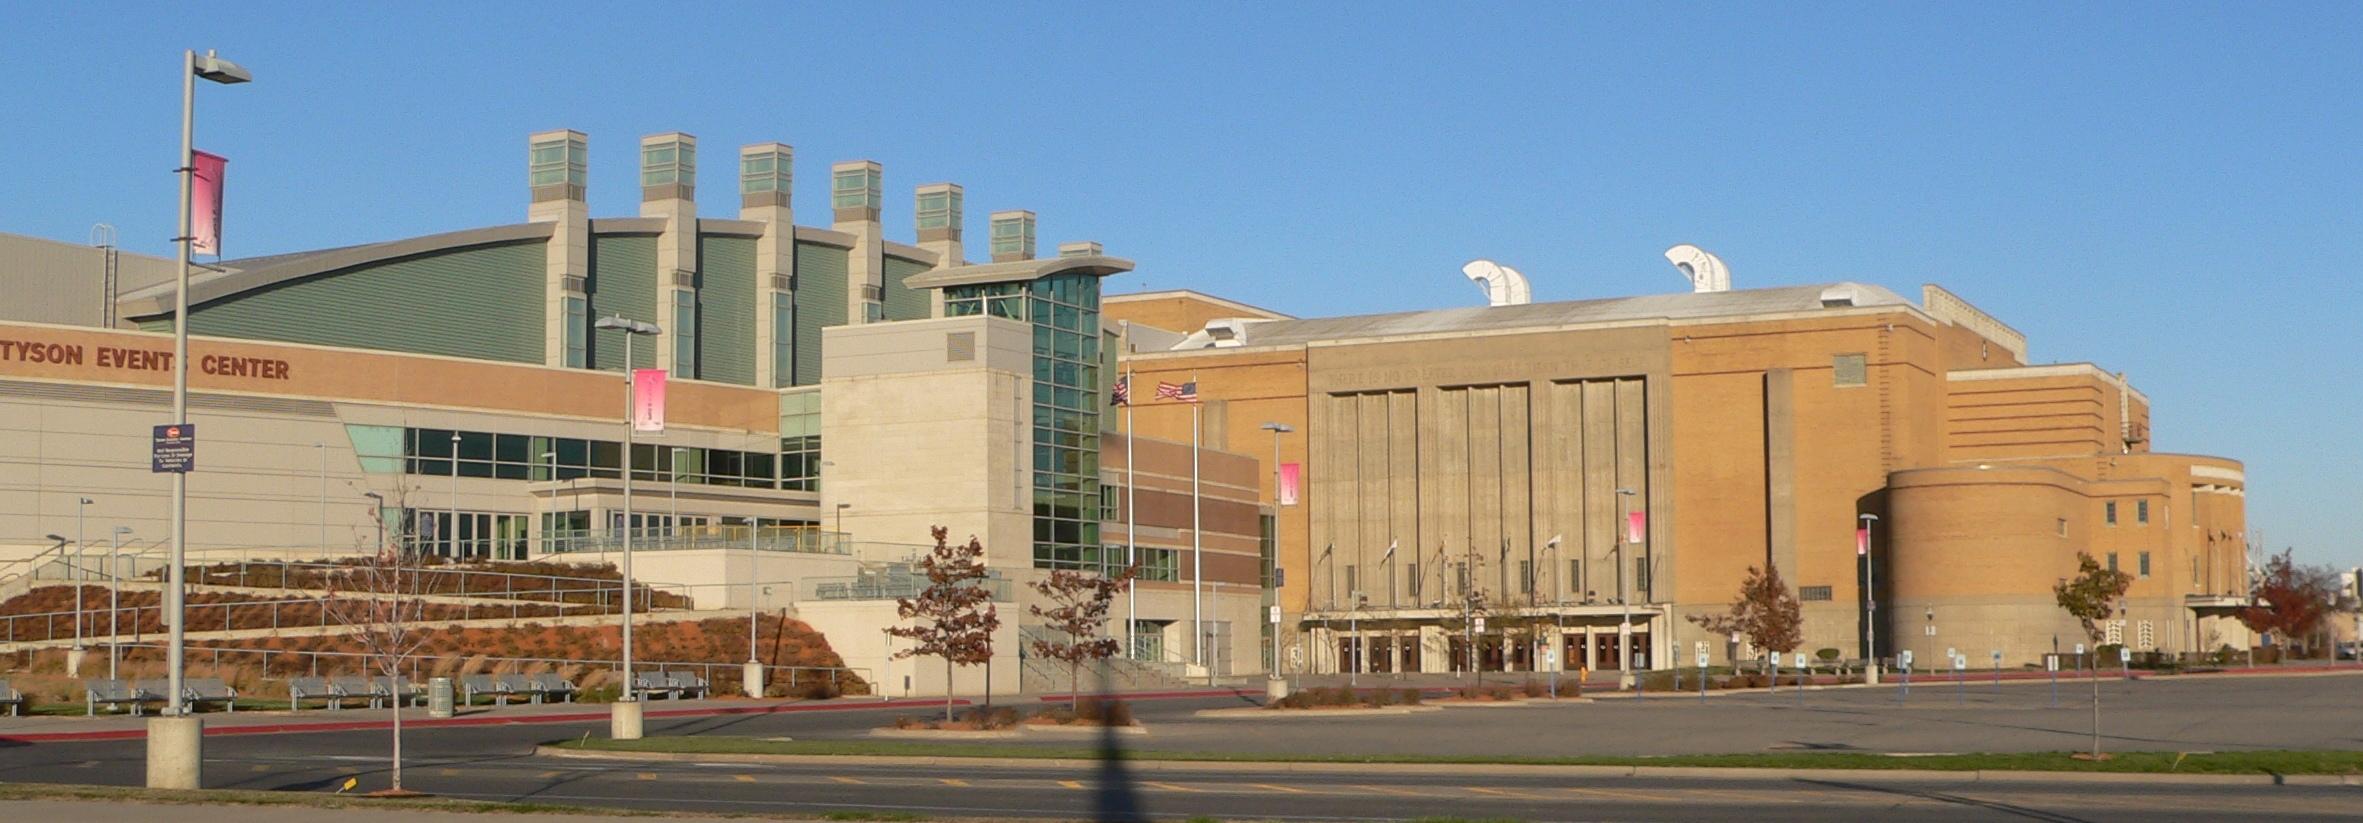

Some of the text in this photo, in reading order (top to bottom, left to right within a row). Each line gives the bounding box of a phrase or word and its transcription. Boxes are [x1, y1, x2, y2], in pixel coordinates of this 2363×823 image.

[0, 340, 289, 379] TYSON EVENT CENTER
